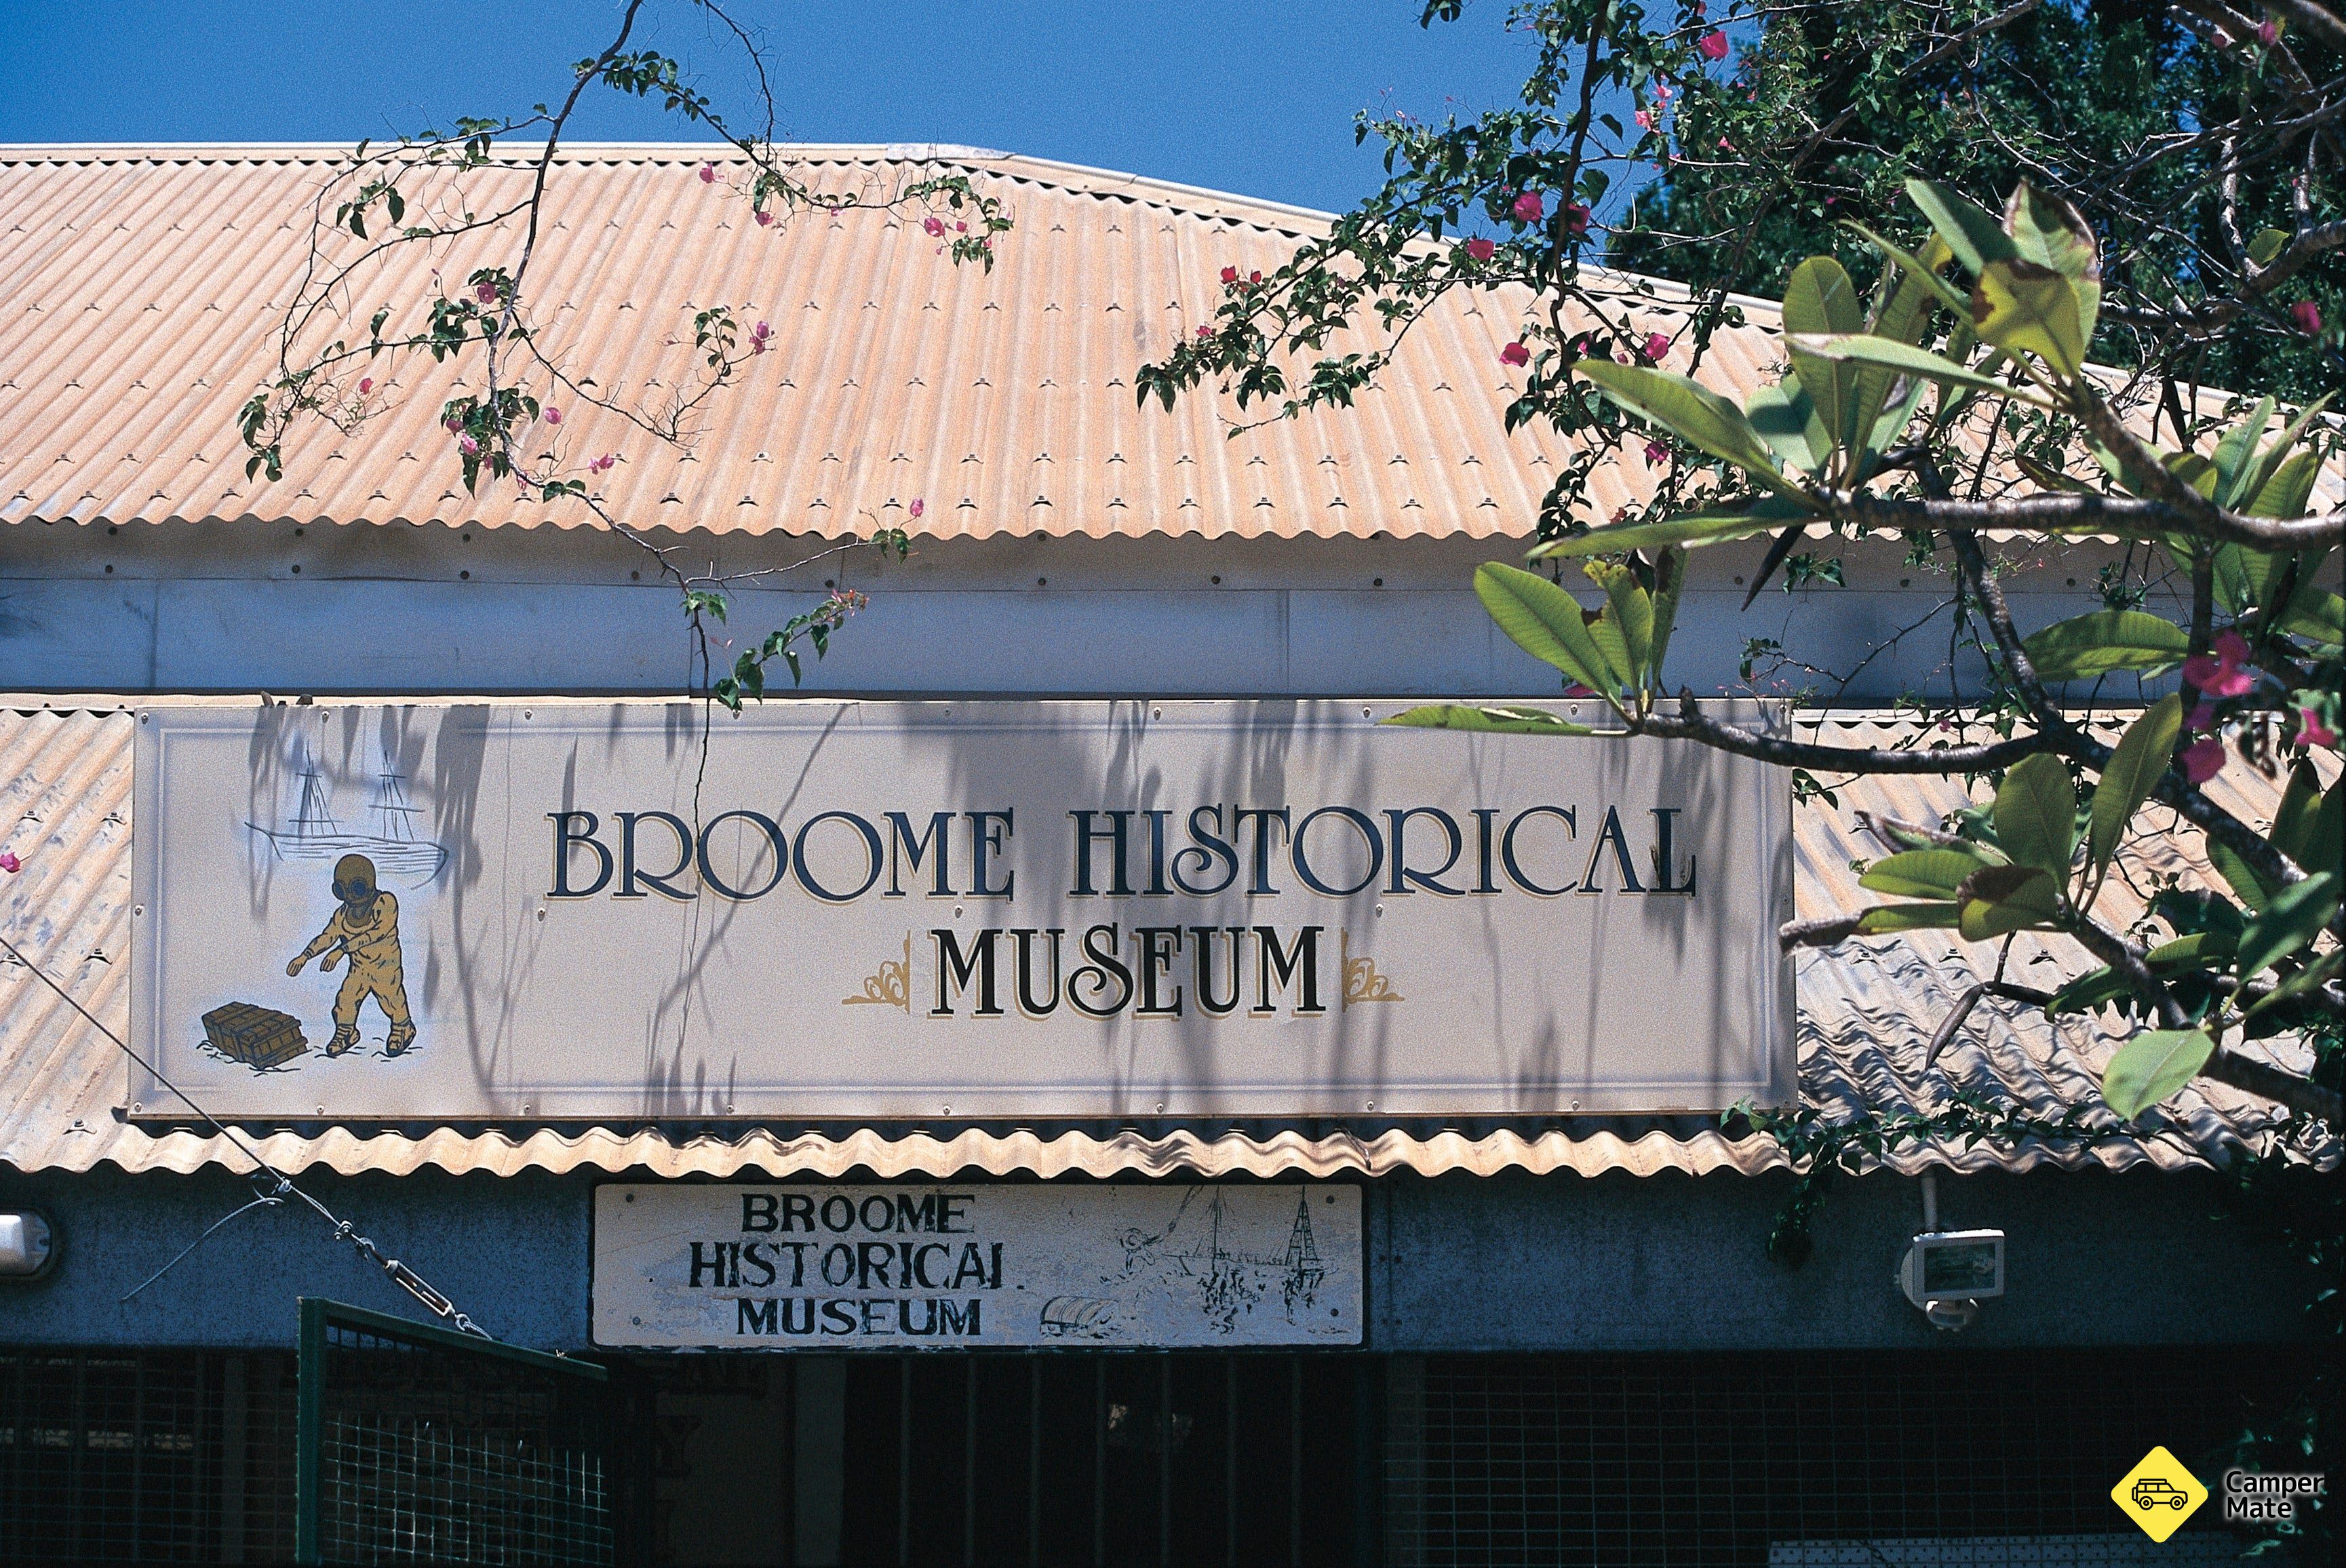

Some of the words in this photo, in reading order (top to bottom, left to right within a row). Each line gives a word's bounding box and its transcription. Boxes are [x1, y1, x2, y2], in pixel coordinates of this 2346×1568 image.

[543, 806, 1014, 903] BROOME
[1066, 804, 1697, 899] HISTORICAL
[926, 922, 1327, 1021] MUSEUM
[741, 1193, 975, 1234] BROOME
[736, 1297, 981, 1336] MUSEUM
